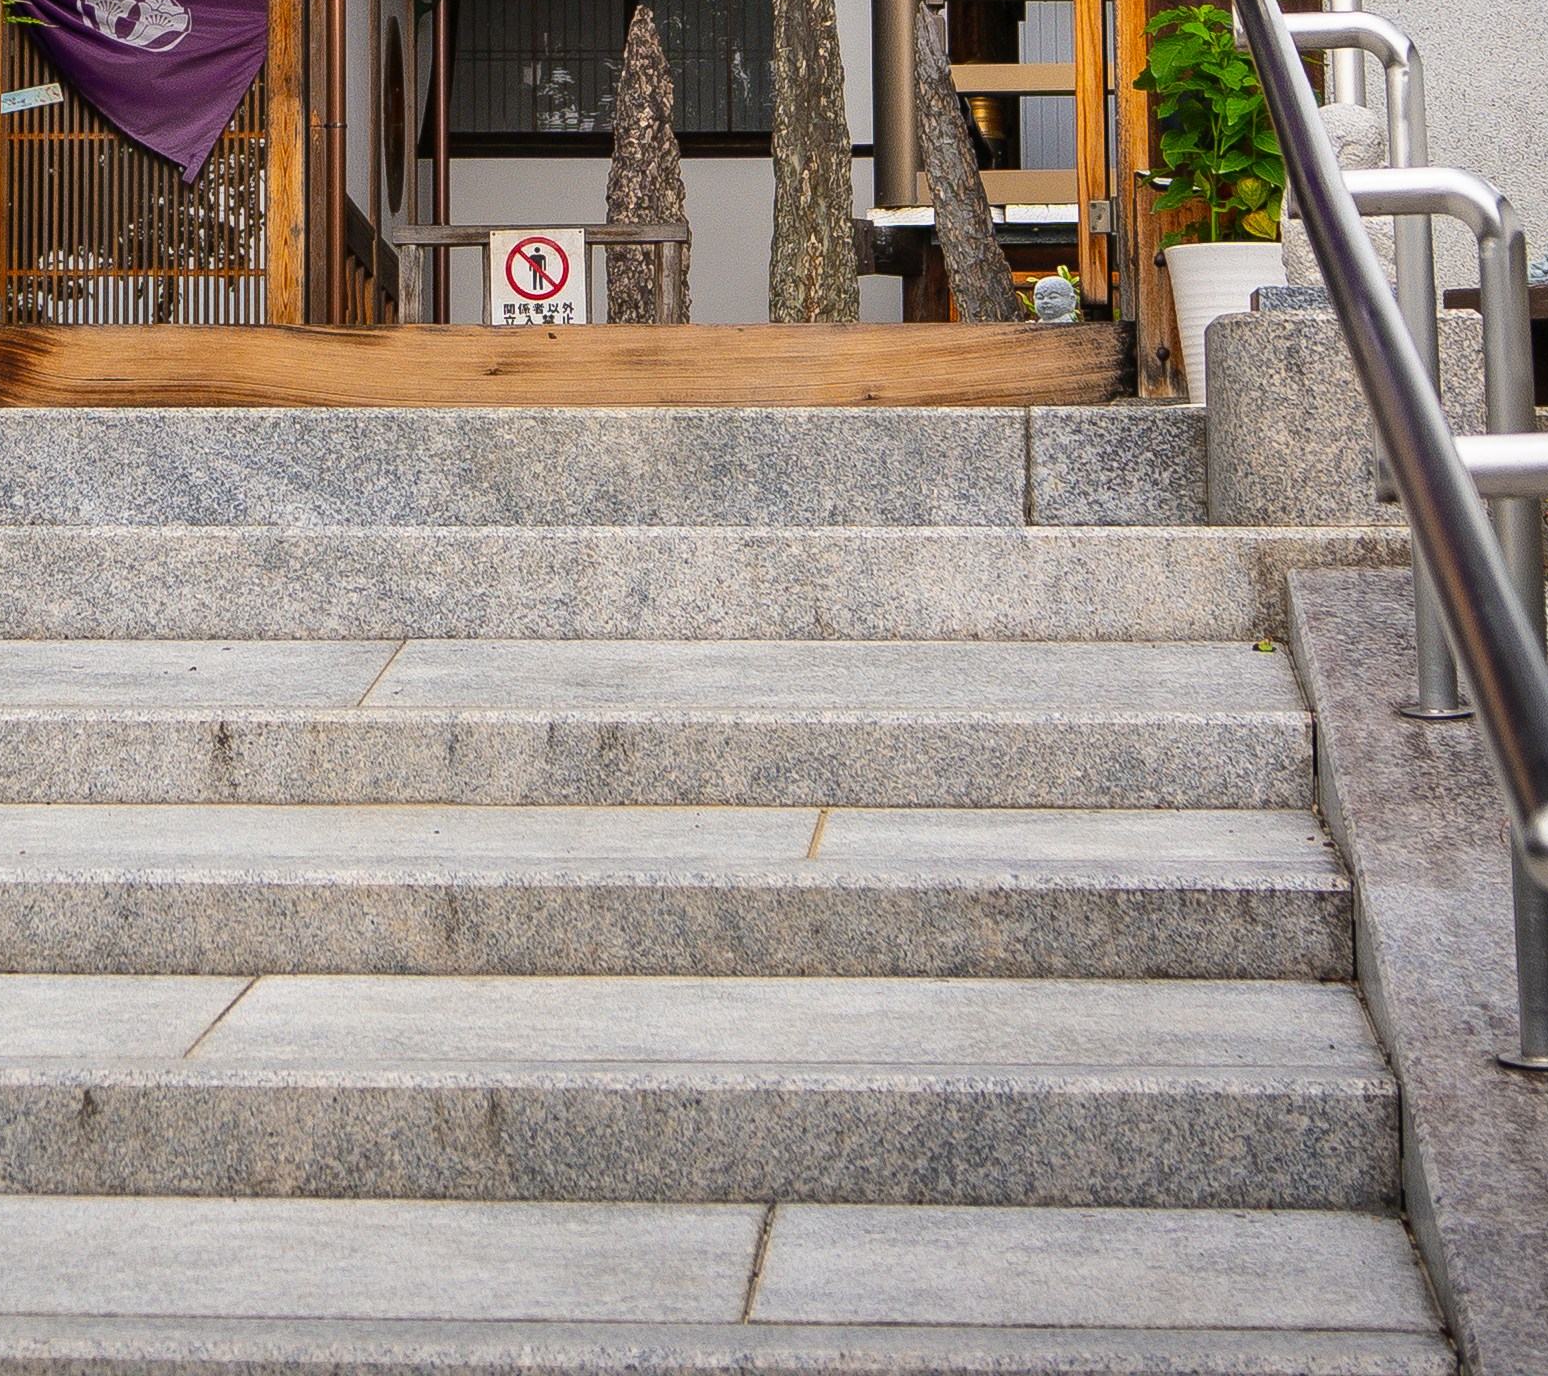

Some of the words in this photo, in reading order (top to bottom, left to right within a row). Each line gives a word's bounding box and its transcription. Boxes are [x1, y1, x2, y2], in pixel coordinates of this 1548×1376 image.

[503, 302, 575, 315] 関係者以外
